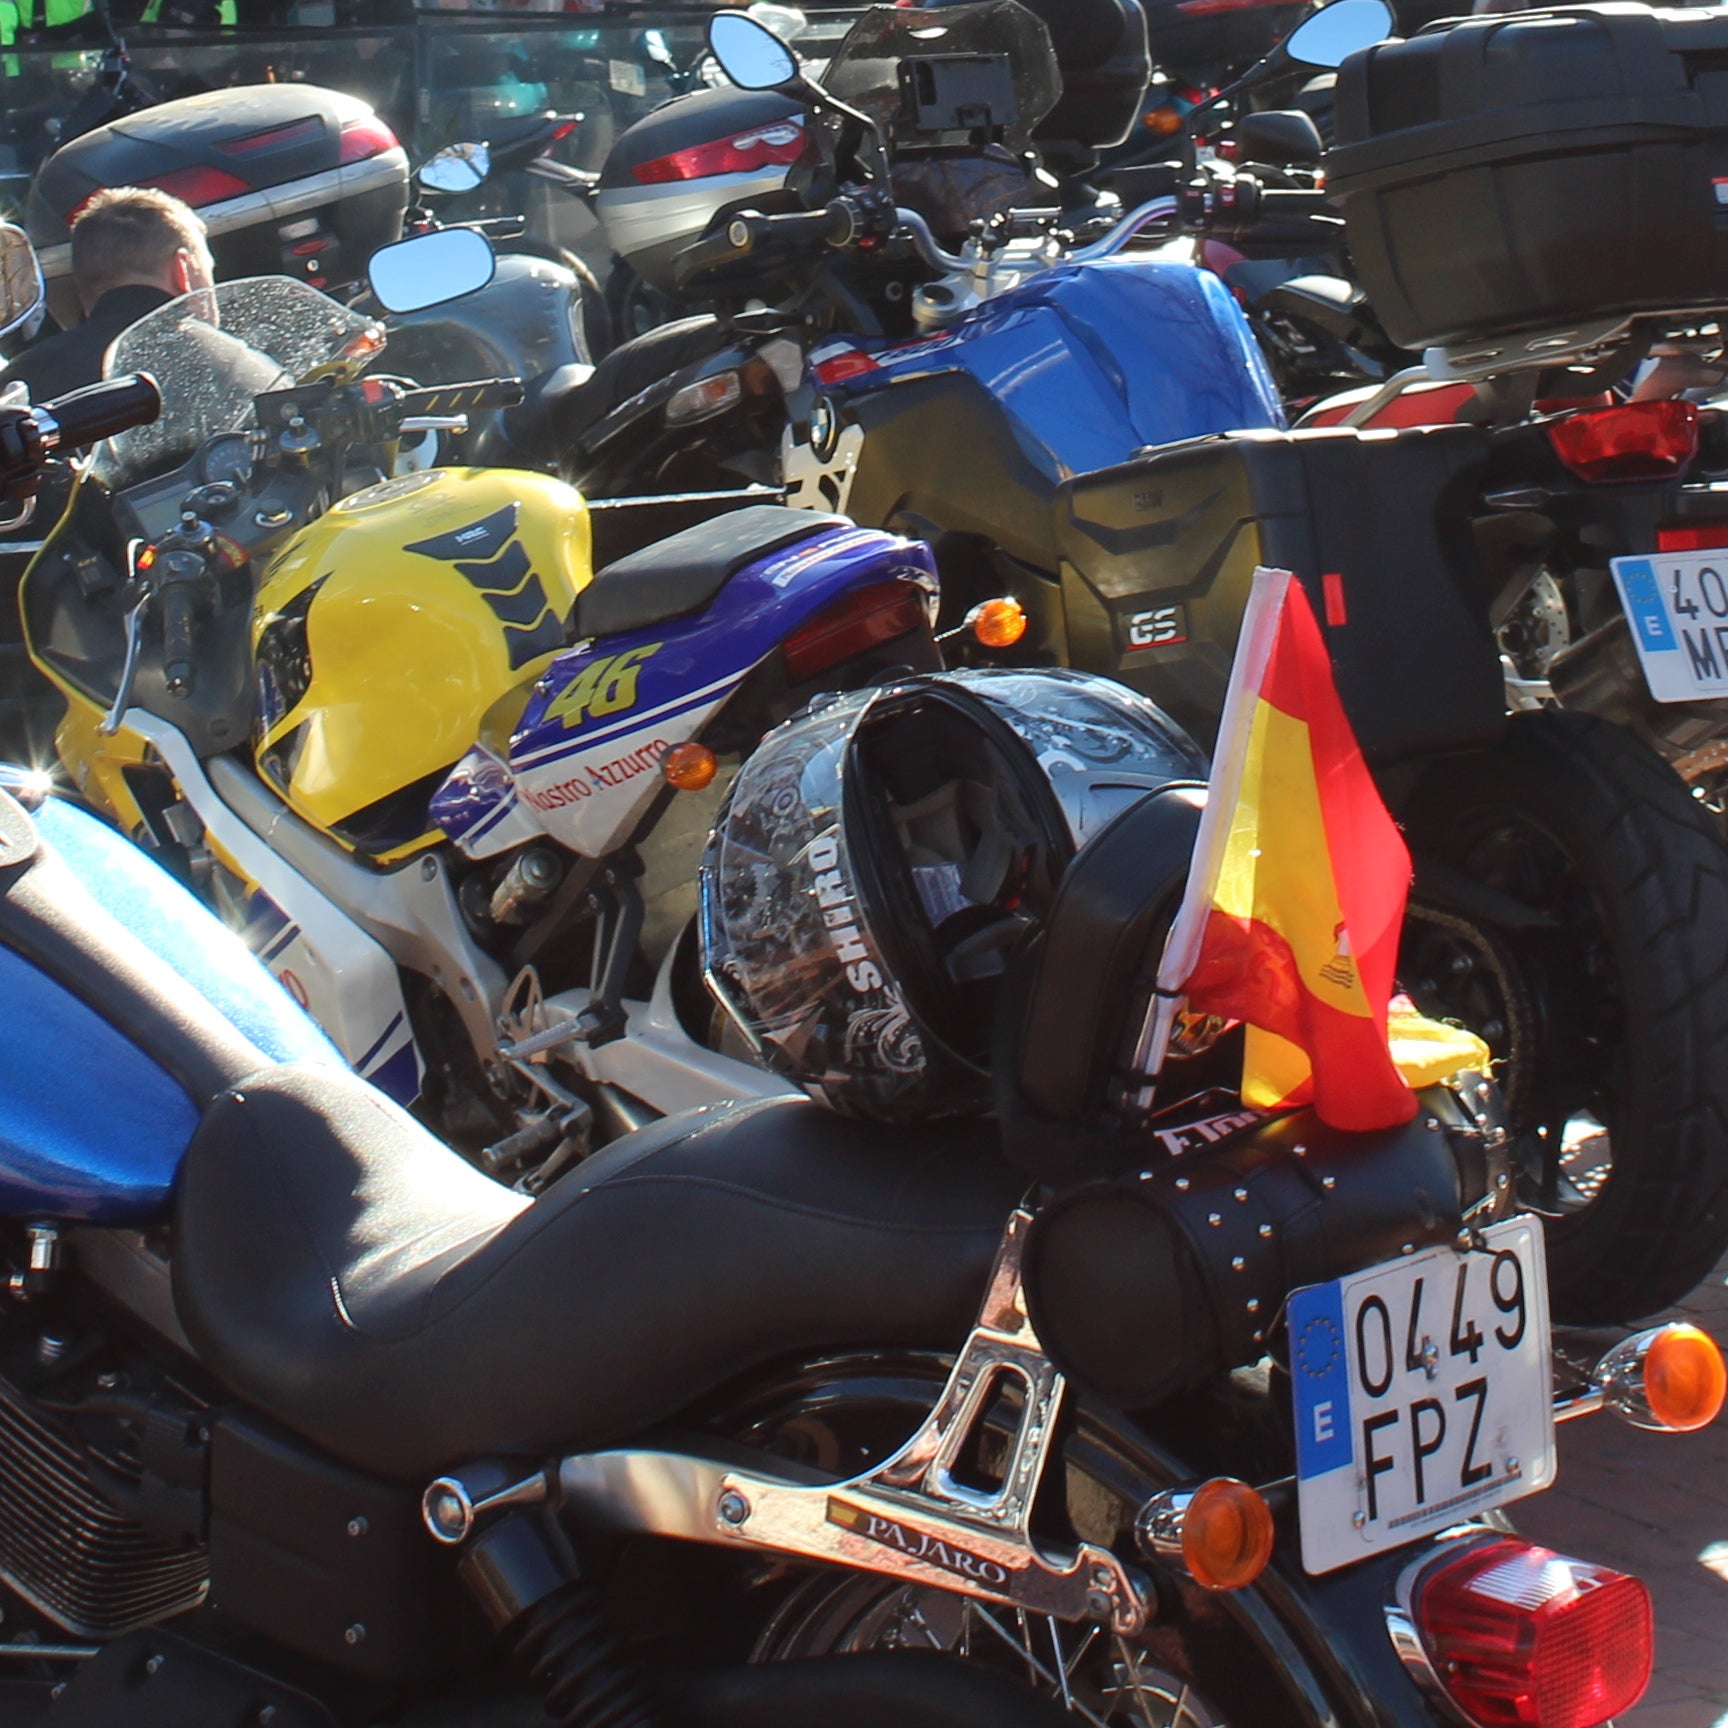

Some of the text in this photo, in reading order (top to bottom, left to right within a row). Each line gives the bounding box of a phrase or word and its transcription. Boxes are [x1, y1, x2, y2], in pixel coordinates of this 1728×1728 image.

[1129, 607, 1177, 646] GS
[1644, 615, 1663, 637] E
[542, 641, 664, 730] 46
[584, 737, 672, 790] Azzurro
[808, 835, 883, 993] SHIRO
[1356, 1248, 1527, 1399] 0449
[1312, 1400, 1336, 1444] E
[1362, 1375, 1493, 1522] FPZ
[865, 1515, 1007, 1584] PAJARO
